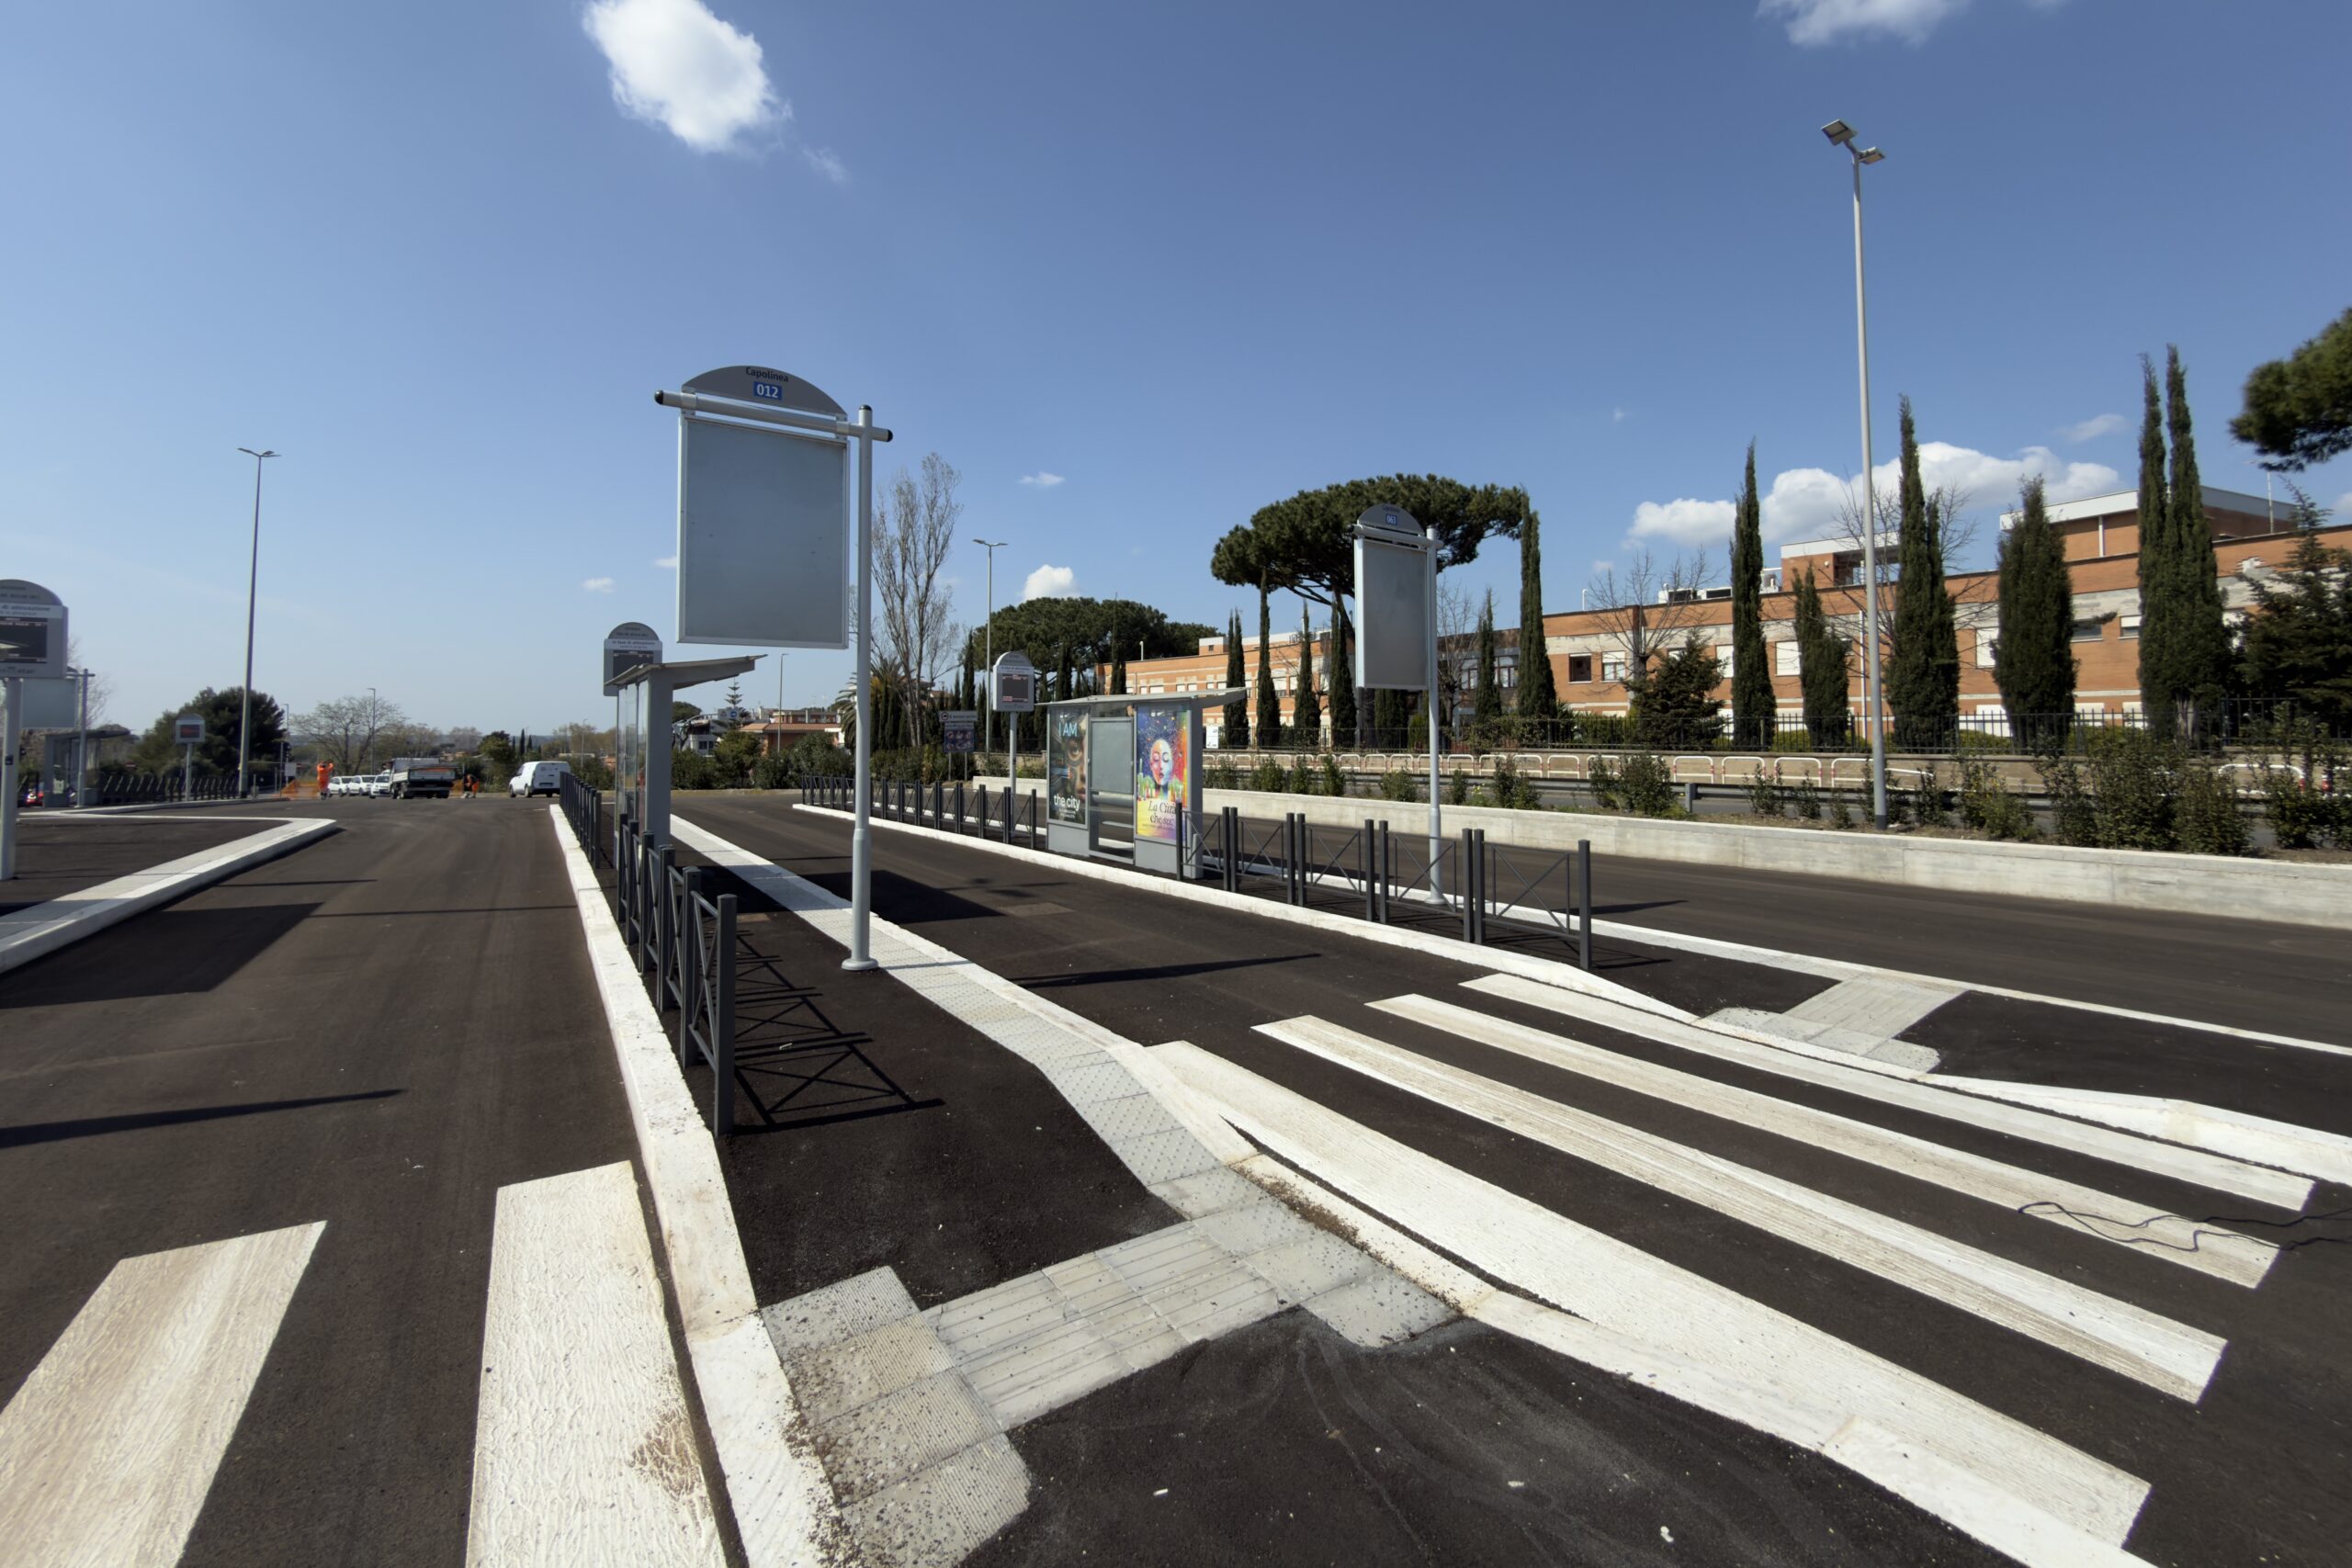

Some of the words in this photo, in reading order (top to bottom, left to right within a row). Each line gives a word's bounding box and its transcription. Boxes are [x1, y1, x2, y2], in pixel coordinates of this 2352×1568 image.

[745, 367, 789, 382] Capolinea
[756, 383, 779, 399] 012
[1063, 722, 1077, 738] AM
[1054, 794, 1066, 807] the
[1067, 795, 1080, 811] city
